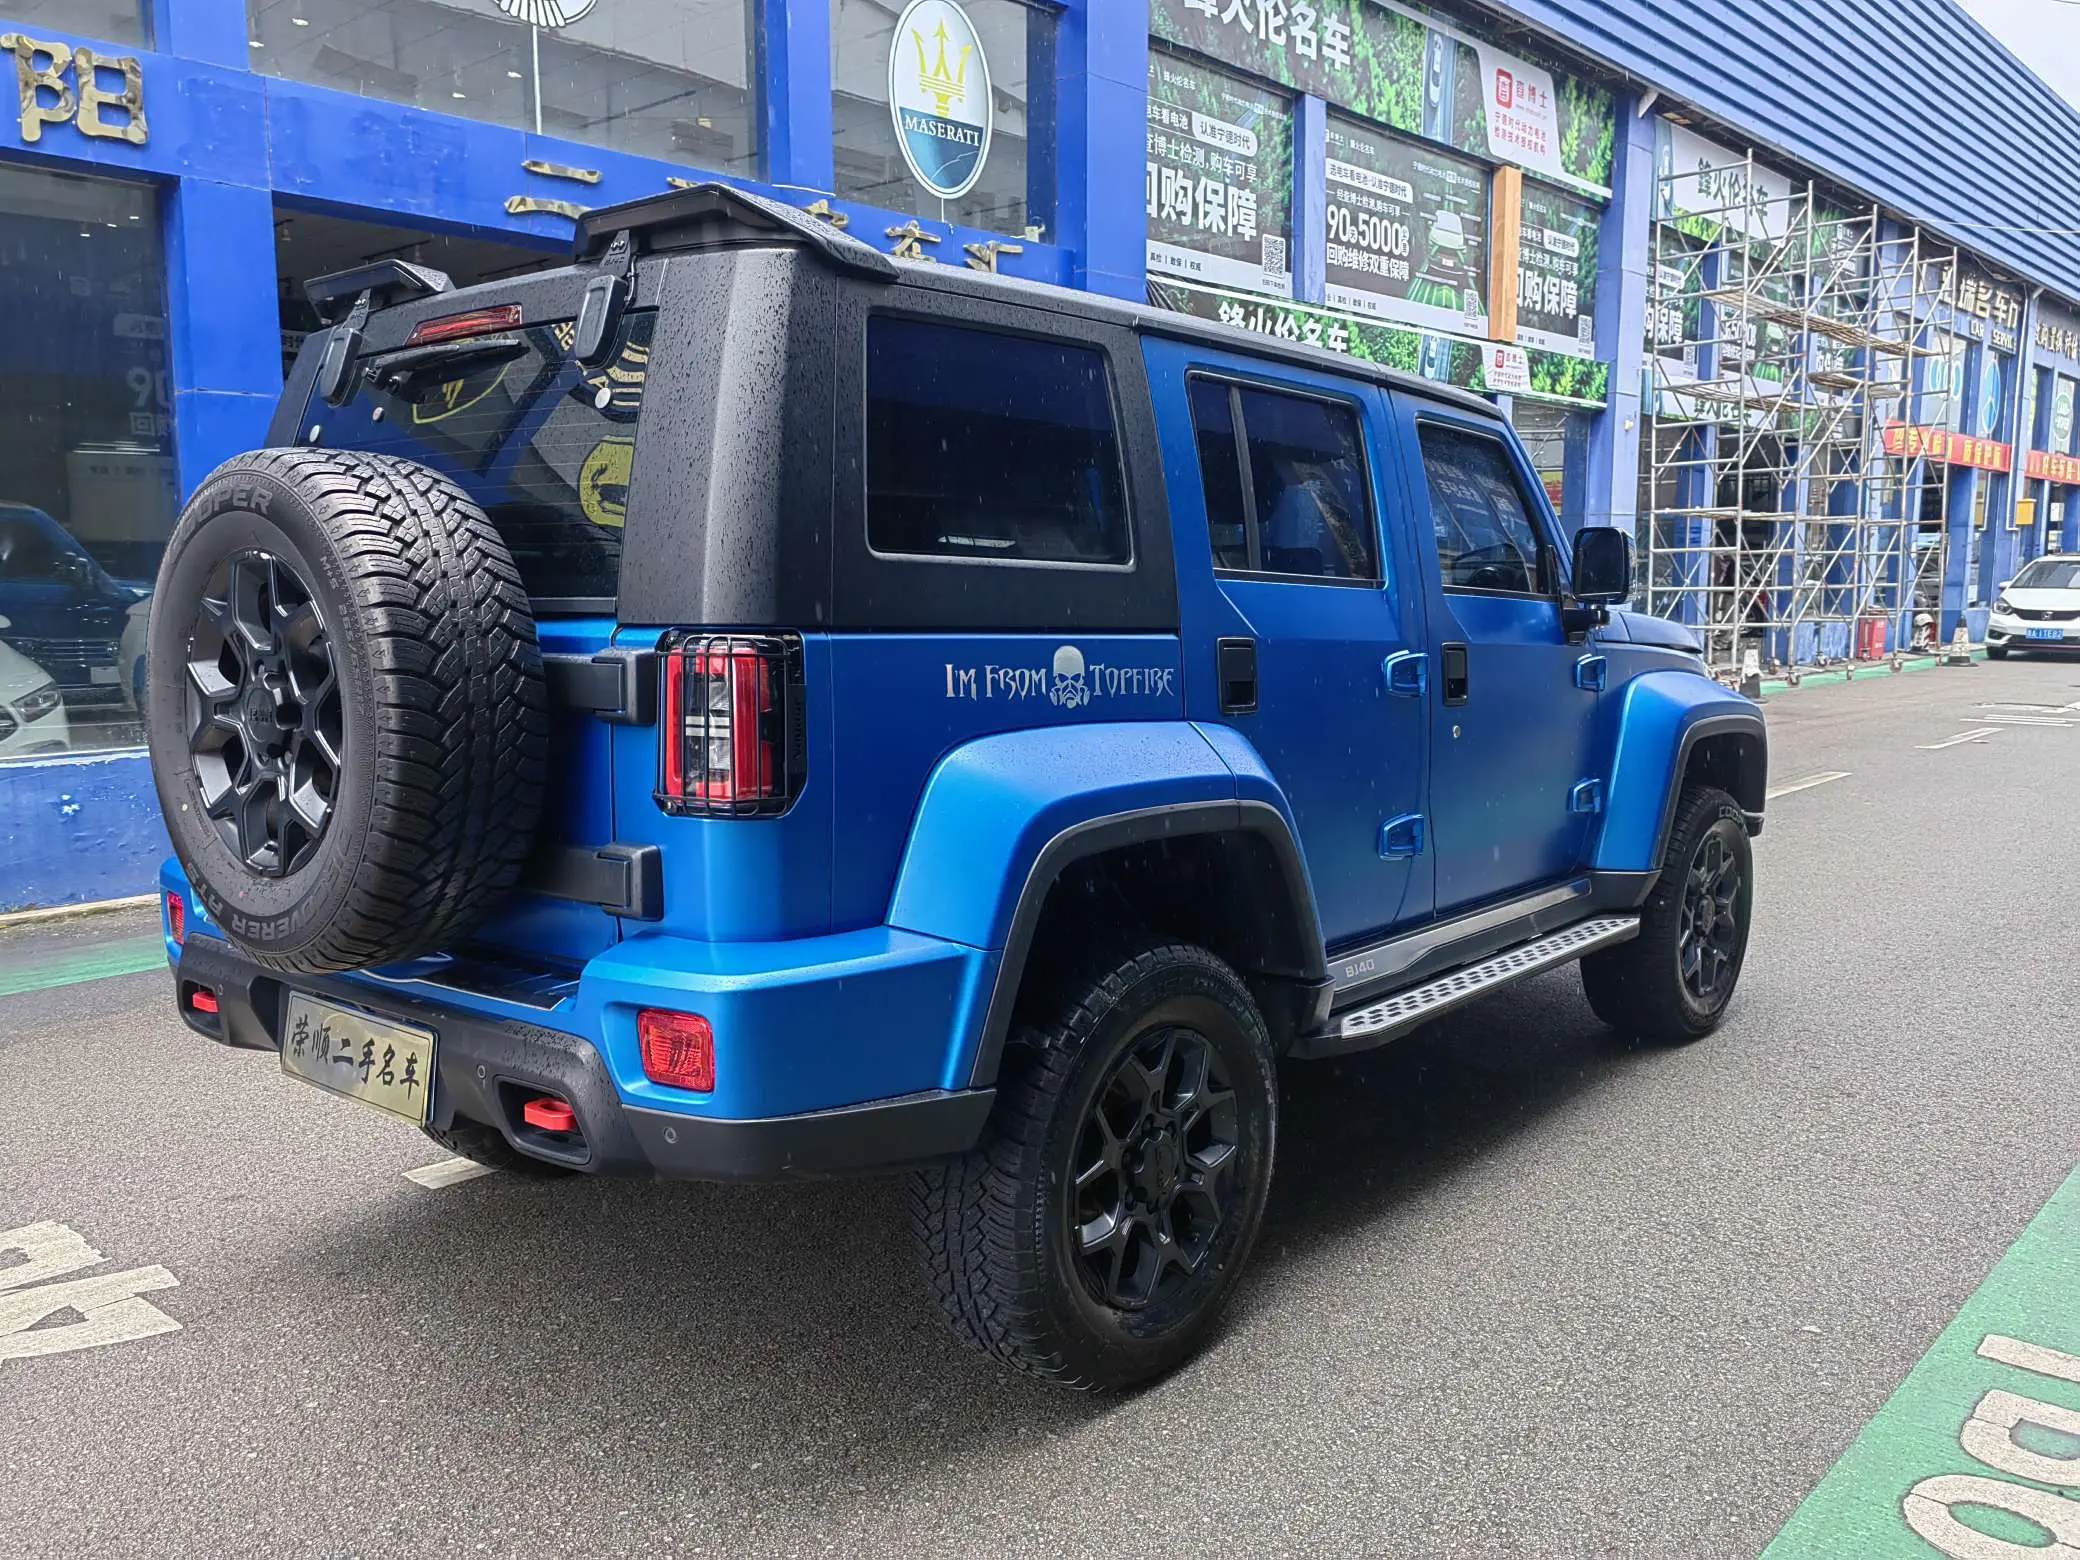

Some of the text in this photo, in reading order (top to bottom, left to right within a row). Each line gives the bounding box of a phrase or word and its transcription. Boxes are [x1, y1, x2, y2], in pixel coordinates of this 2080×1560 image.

[904, 114, 980, 147] MASERATI
[984, 664, 1048, 701] FROM
[1089, 662, 1175, 698] TOPFIRE
[1345, 958, 1376, 978] BJ40
[291, 1013, 420, 1101] 荣顺二手名车
